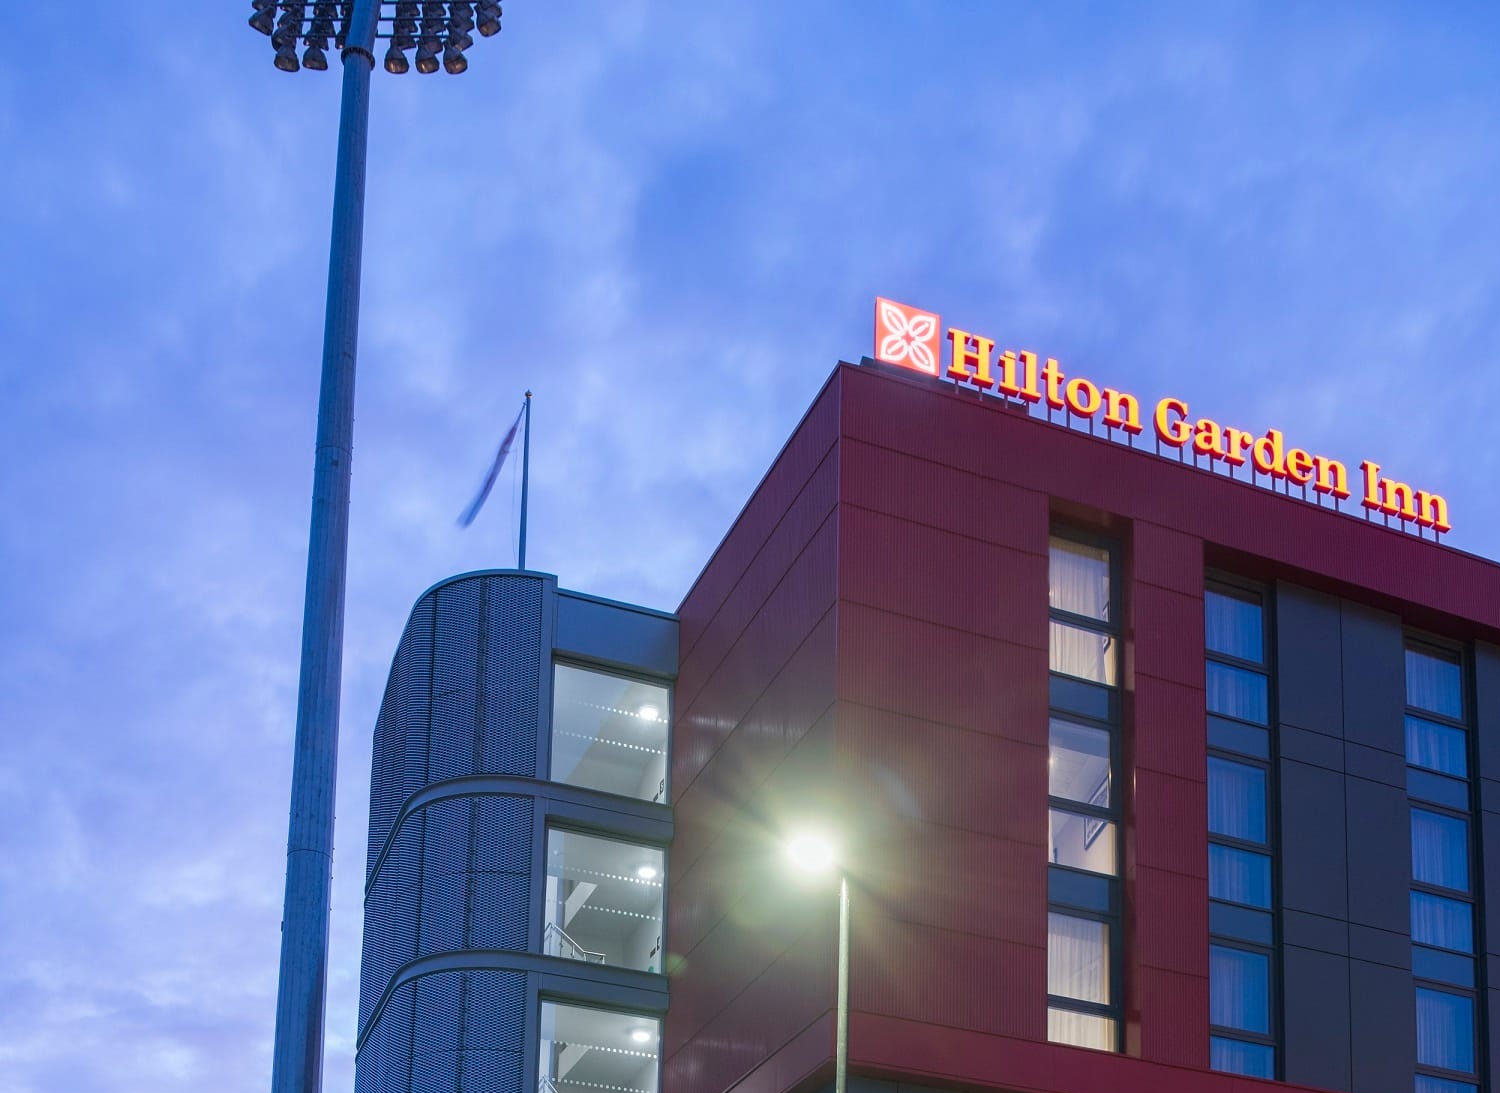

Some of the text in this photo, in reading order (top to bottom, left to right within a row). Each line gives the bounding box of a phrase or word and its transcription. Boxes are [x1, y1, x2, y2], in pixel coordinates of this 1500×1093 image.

[946, 327, 1452, 534] Hilton Garden Inn
